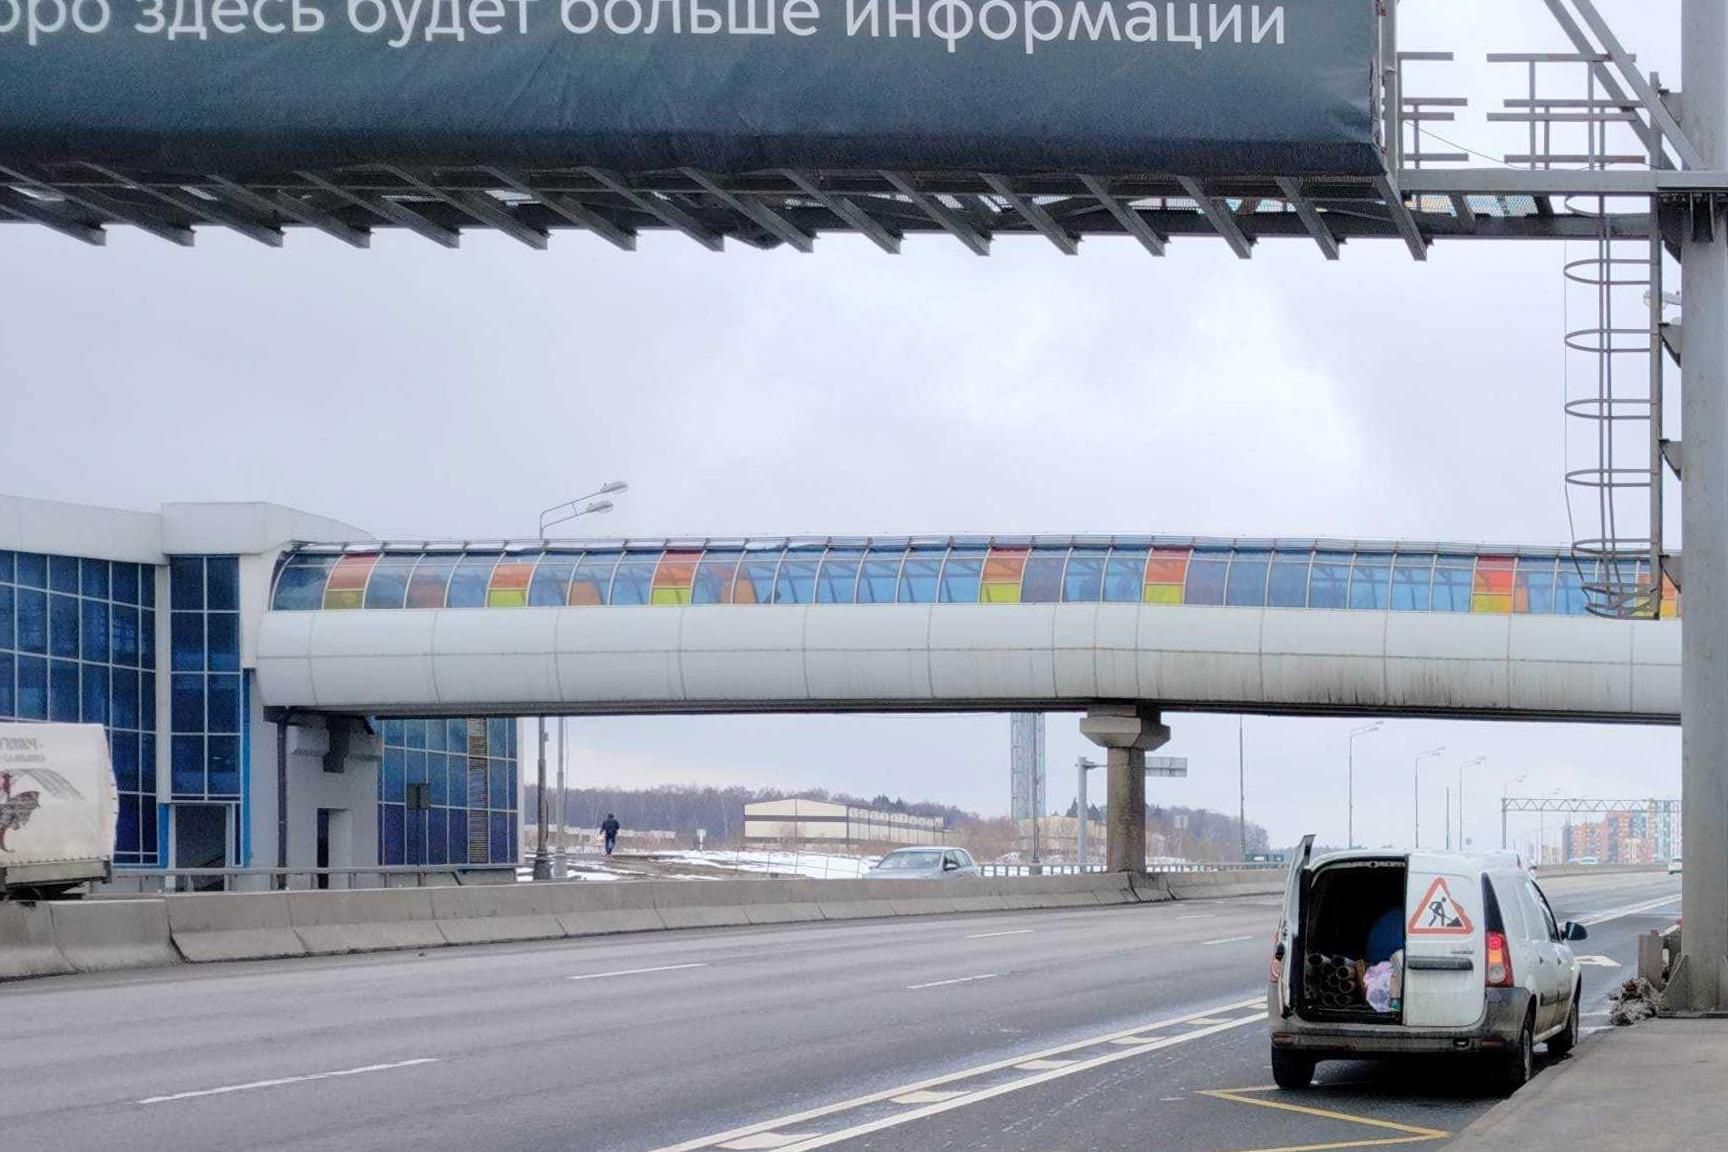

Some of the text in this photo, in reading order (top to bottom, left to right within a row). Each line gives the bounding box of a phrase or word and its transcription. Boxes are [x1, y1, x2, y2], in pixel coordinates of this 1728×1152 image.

[134, 0, 325, 41] здесь
[348, 0, 534, 48] будет
[561, 0, 820, 35] больше
[845, 0, 1286, 53] информации
